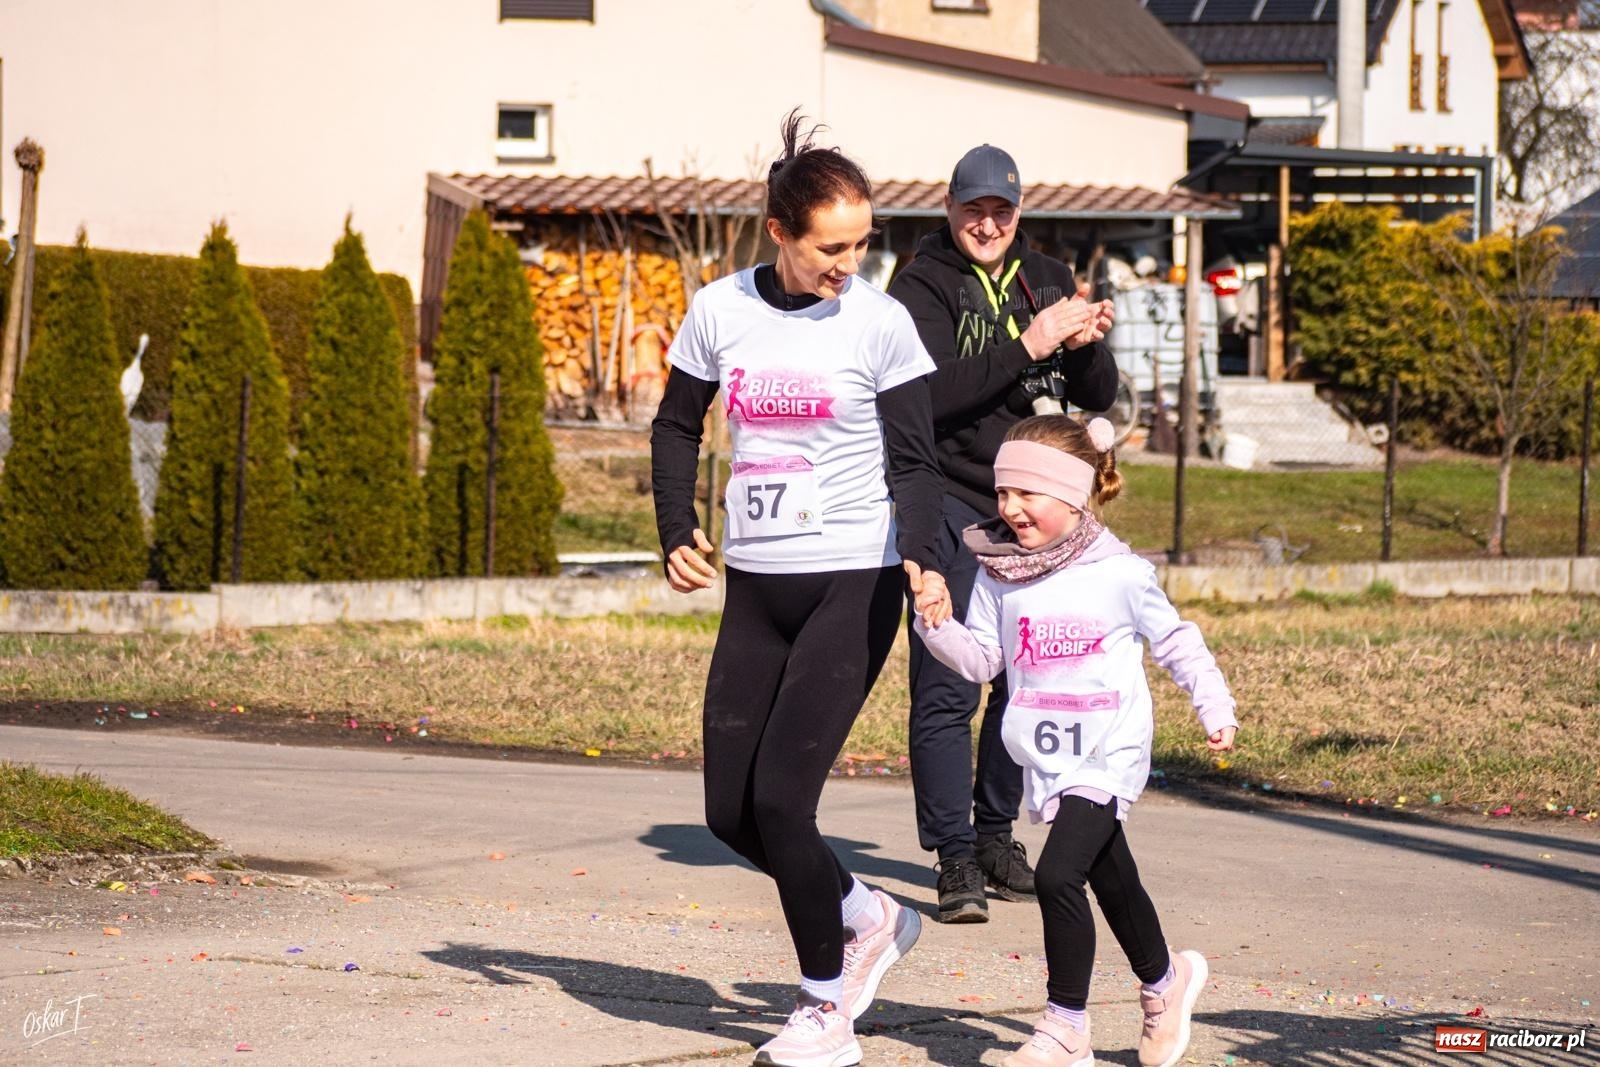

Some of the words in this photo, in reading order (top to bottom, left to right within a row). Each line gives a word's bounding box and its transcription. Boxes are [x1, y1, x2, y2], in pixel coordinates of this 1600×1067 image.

[748, 378, 800, 397] BIEG
[751, 398, 821, 416] KOBIET
[747, 482, 787, 521] 57
[1036, 622, 1080, 640] BIEG
[1040, 640, 1096, 657] KOBIET
[1039, 697, 1056, 706] BIEG
[1057, 699, 1084, 708] KOBIET
[1034, 720, 1082, 756] 61
